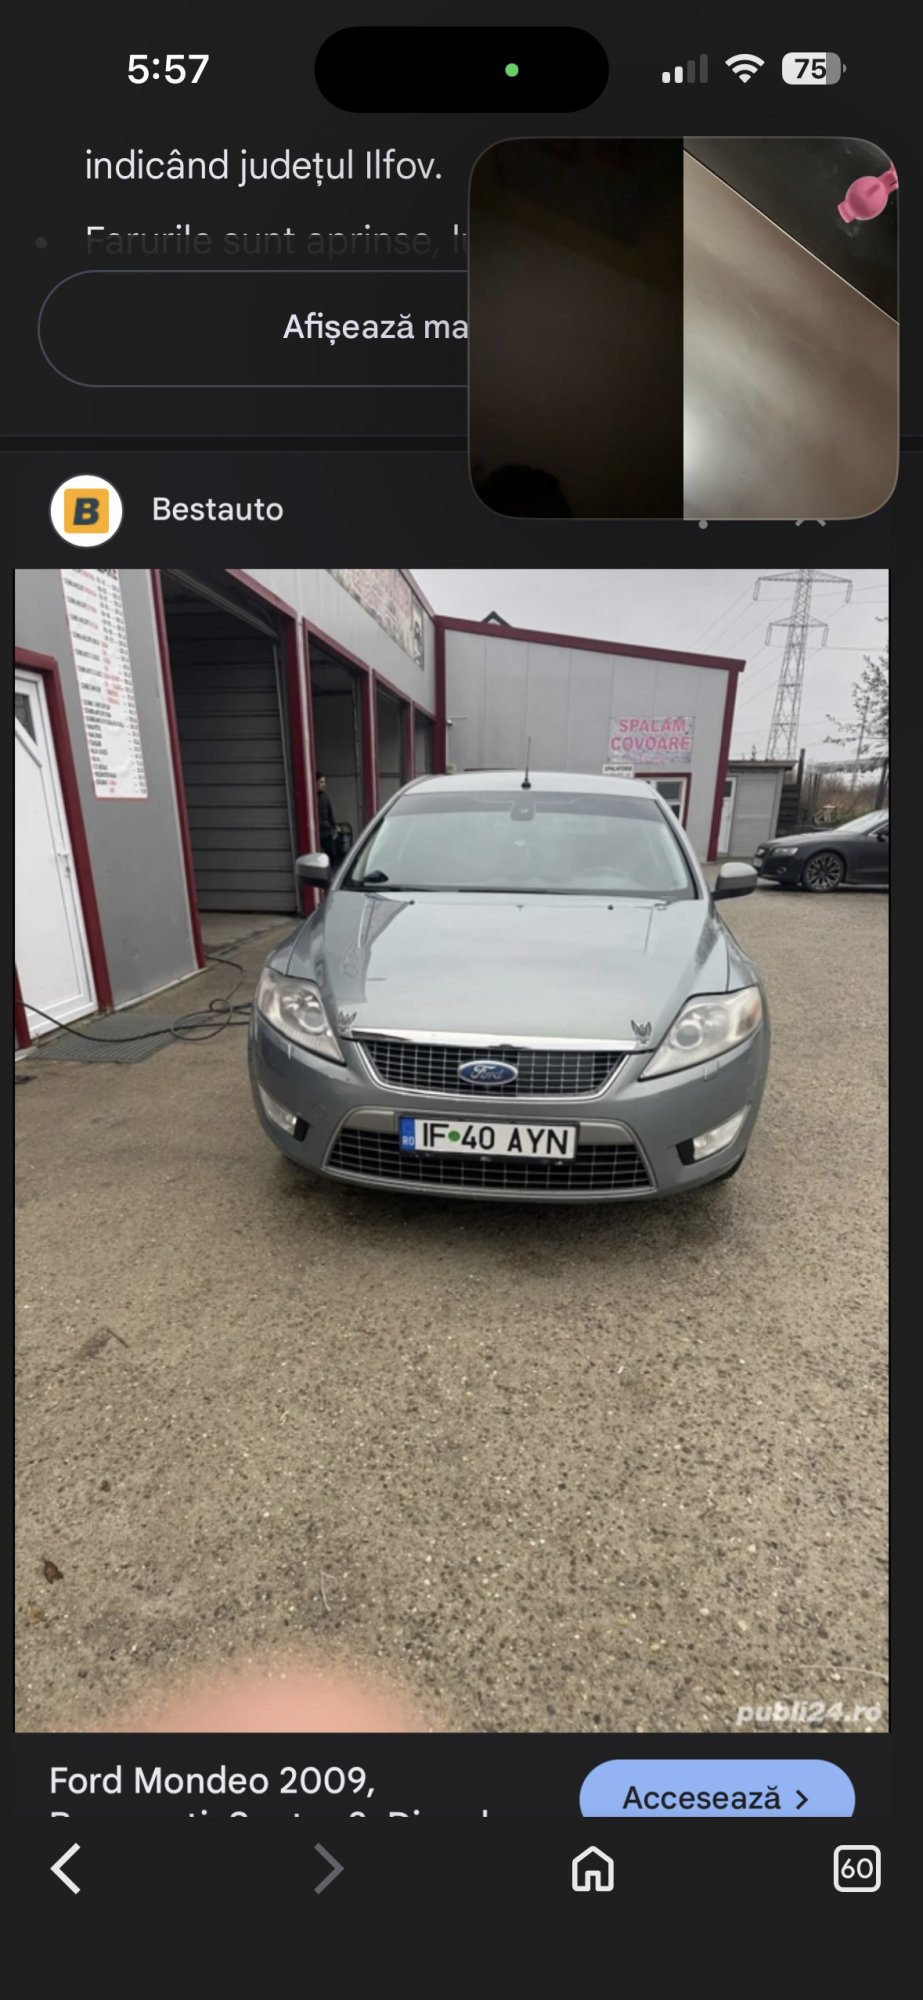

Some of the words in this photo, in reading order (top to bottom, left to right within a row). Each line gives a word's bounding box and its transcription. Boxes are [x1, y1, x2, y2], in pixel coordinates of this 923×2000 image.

[128, 54, 209, 84] 5:57
[794, 58, 827, 80] 75
[85, 149, 229, 179] indicând
[238, 149, 353, 187] județul
[366, 148, 442, 179] Ilfov.
[85, 223, 212, 254] Farurile
[224, 226, 297, 254] sunt
[307, 224, 442, 261] aprinse,
[283, 312, 415, 345] Afișează
[73, 497, 100, 526] B
[154, 497, 284, 522] Bestauto
[610, 736, 691, 751] COVOARE
[470, 1064, 505, 1079] Ford
[402, 1135, 415, 1146] RO
[423, 1122, 449, 1147] IF
[461, 1125, 495, 1150] 40
[507, 1127, 568, 1154] AYN
[51, 1765, 121, 1795] Ford
[135, 1765, 270, 1795] Mondeo
[280, 1766, 375, 1799] 2009,
[622, 1786, 782, 1810] Accesează
[841, 1858, 874, 1880] 60
